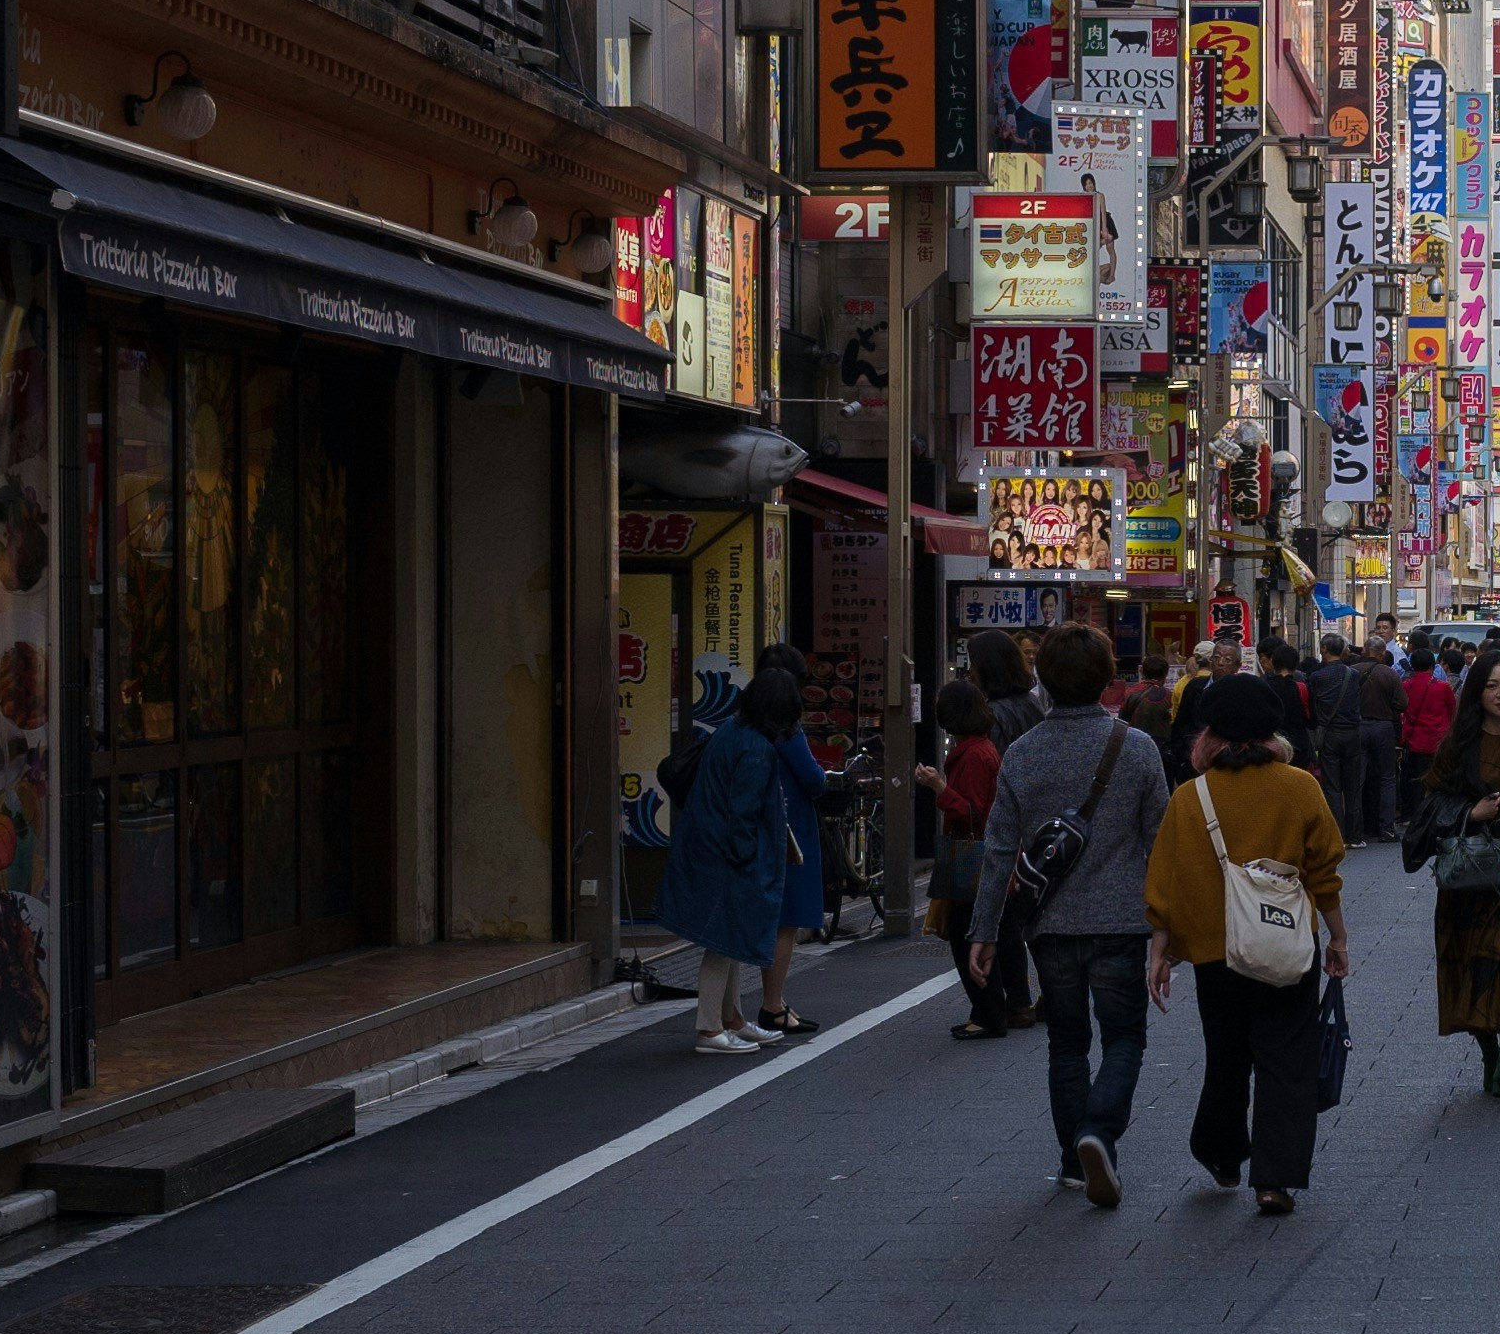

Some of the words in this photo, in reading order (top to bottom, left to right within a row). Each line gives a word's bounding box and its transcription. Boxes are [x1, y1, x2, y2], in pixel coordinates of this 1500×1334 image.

[1006, 22, 1035, 34] CUP
[1088, 25, 1103, 40] 肉
[1084, 68, 1175, 89] XROSS
[1095, 90, 1166, 110] CASA
[1192, 59, 1205, 143] ワイン飲み放題
[1412, 69, 1443, 189] カラオケ
[1058, 134, 1131, 151] マッサージ
[1019, 200, 1047, 215] 2F
[1411, 193, 1443, 211] 747
[1004, 222, 1088, 247] タイ古式
[79, 232, 149, 280] Trattoria
[152, 251, 211, 294] Pizzeria
[215, 273, 239, 299] Bar
[980, 247, 1088, 269] マッサージ
[1021, 295, 1077, 308] Relax
[1458, 224, 1486, 363] カラオケ
[980, 328, 1088, 391] 湖南
[1004, 393, 1085, 444] 菜館
[729, 543, 743, 579] Tuna
[704, 568, 721, 652] 金枪鱼餐厅
[729, 583, 743, 667] Restaurant
